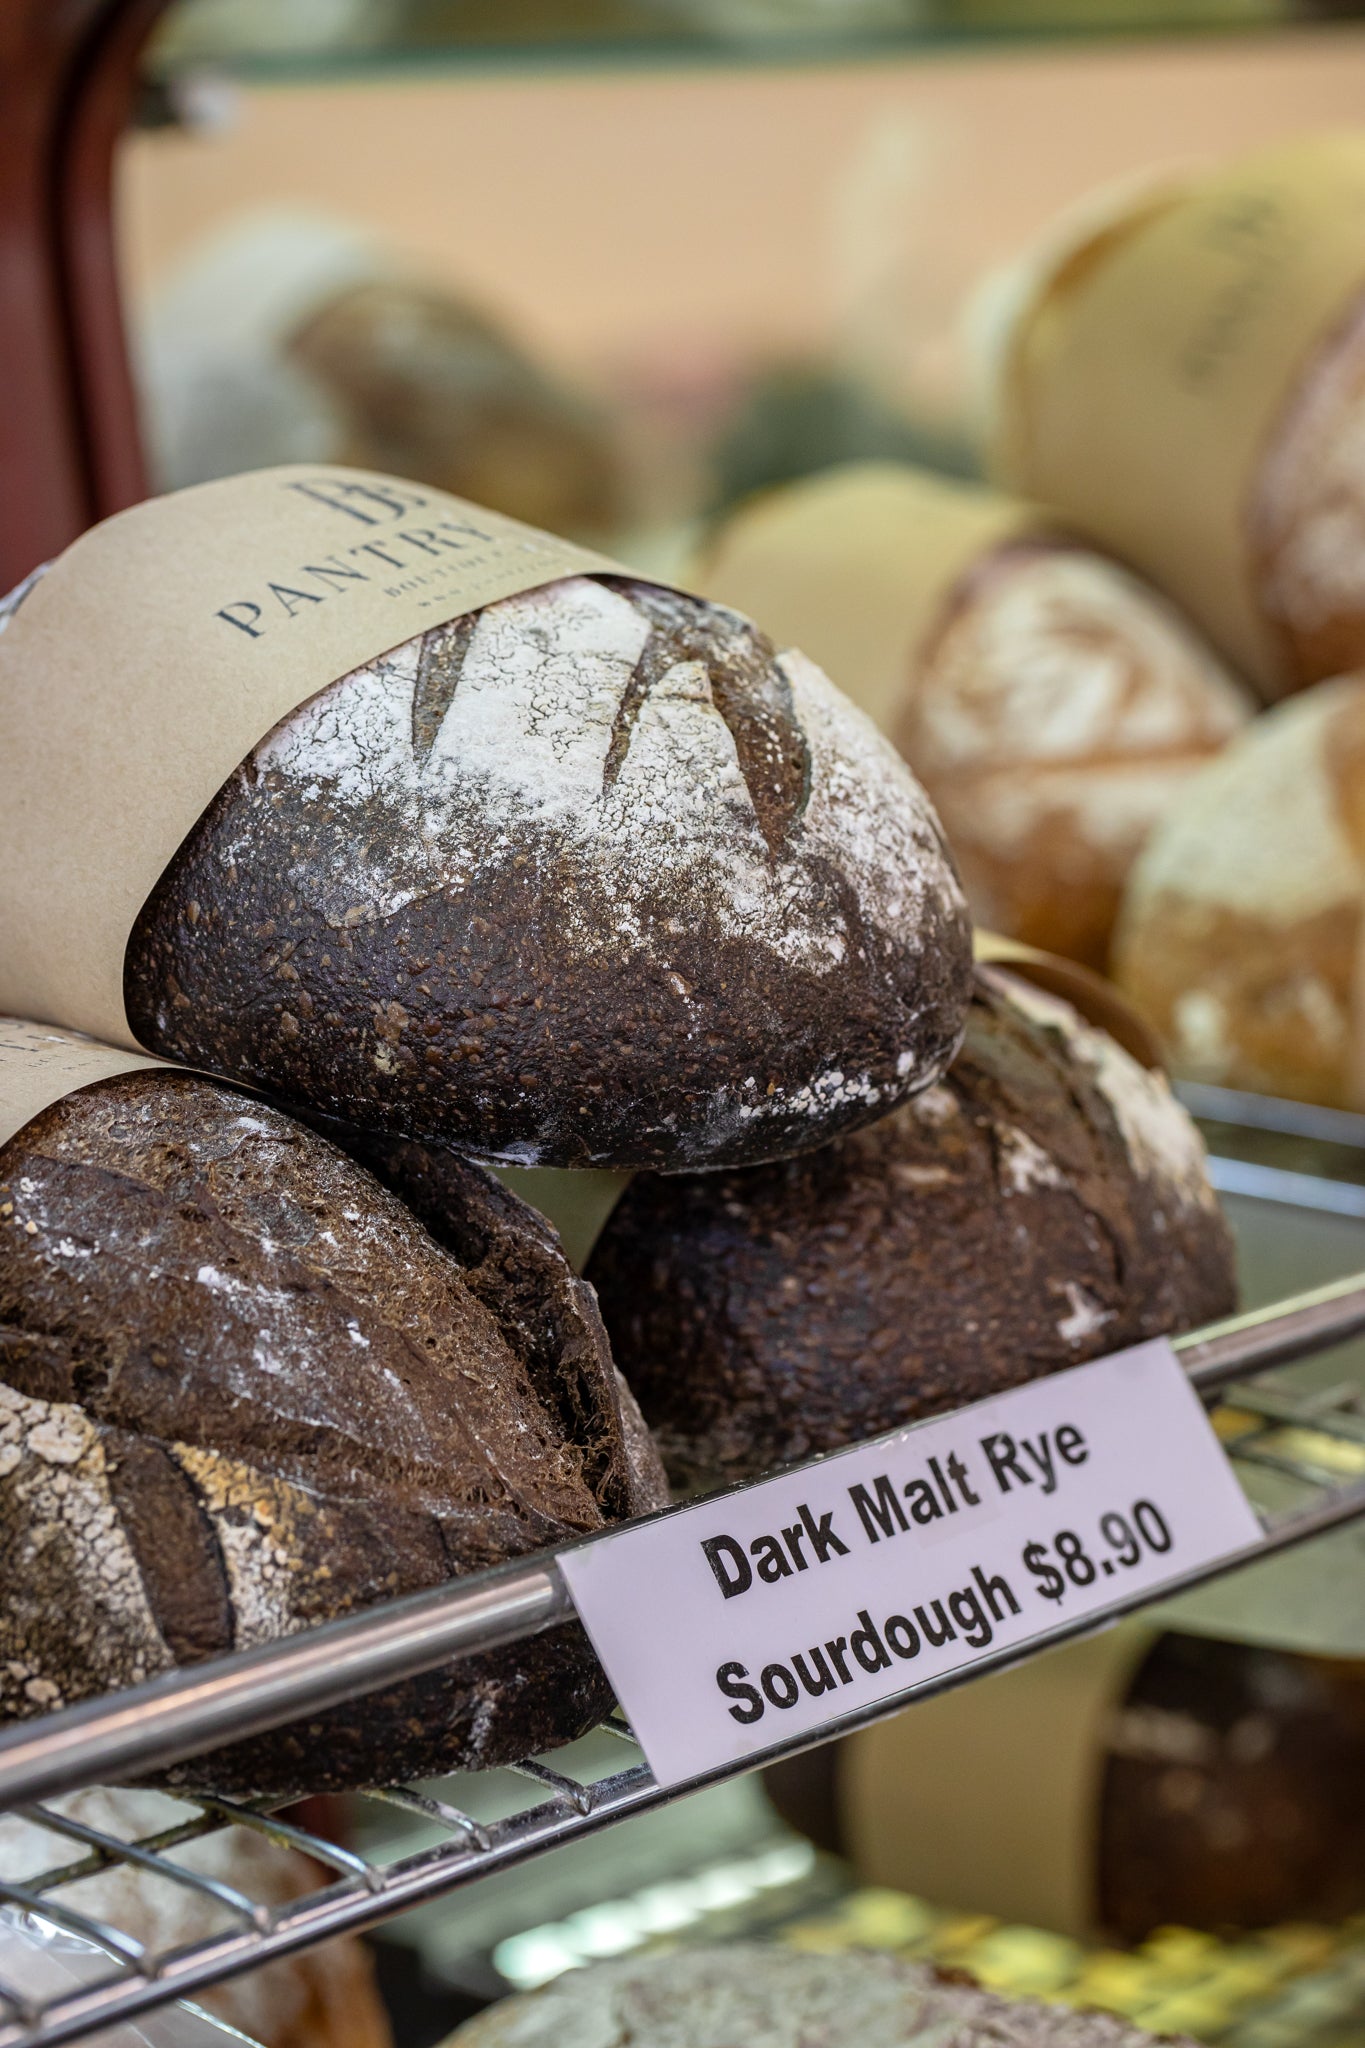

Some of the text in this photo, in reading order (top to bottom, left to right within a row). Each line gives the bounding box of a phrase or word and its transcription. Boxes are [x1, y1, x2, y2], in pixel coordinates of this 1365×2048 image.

[213, 519, 495, 640] PANTRY
[700, 1424, 1090, 1600] Dark Malt Rye
[715, 1500, 1173, 1725] Sourdough $8.90
